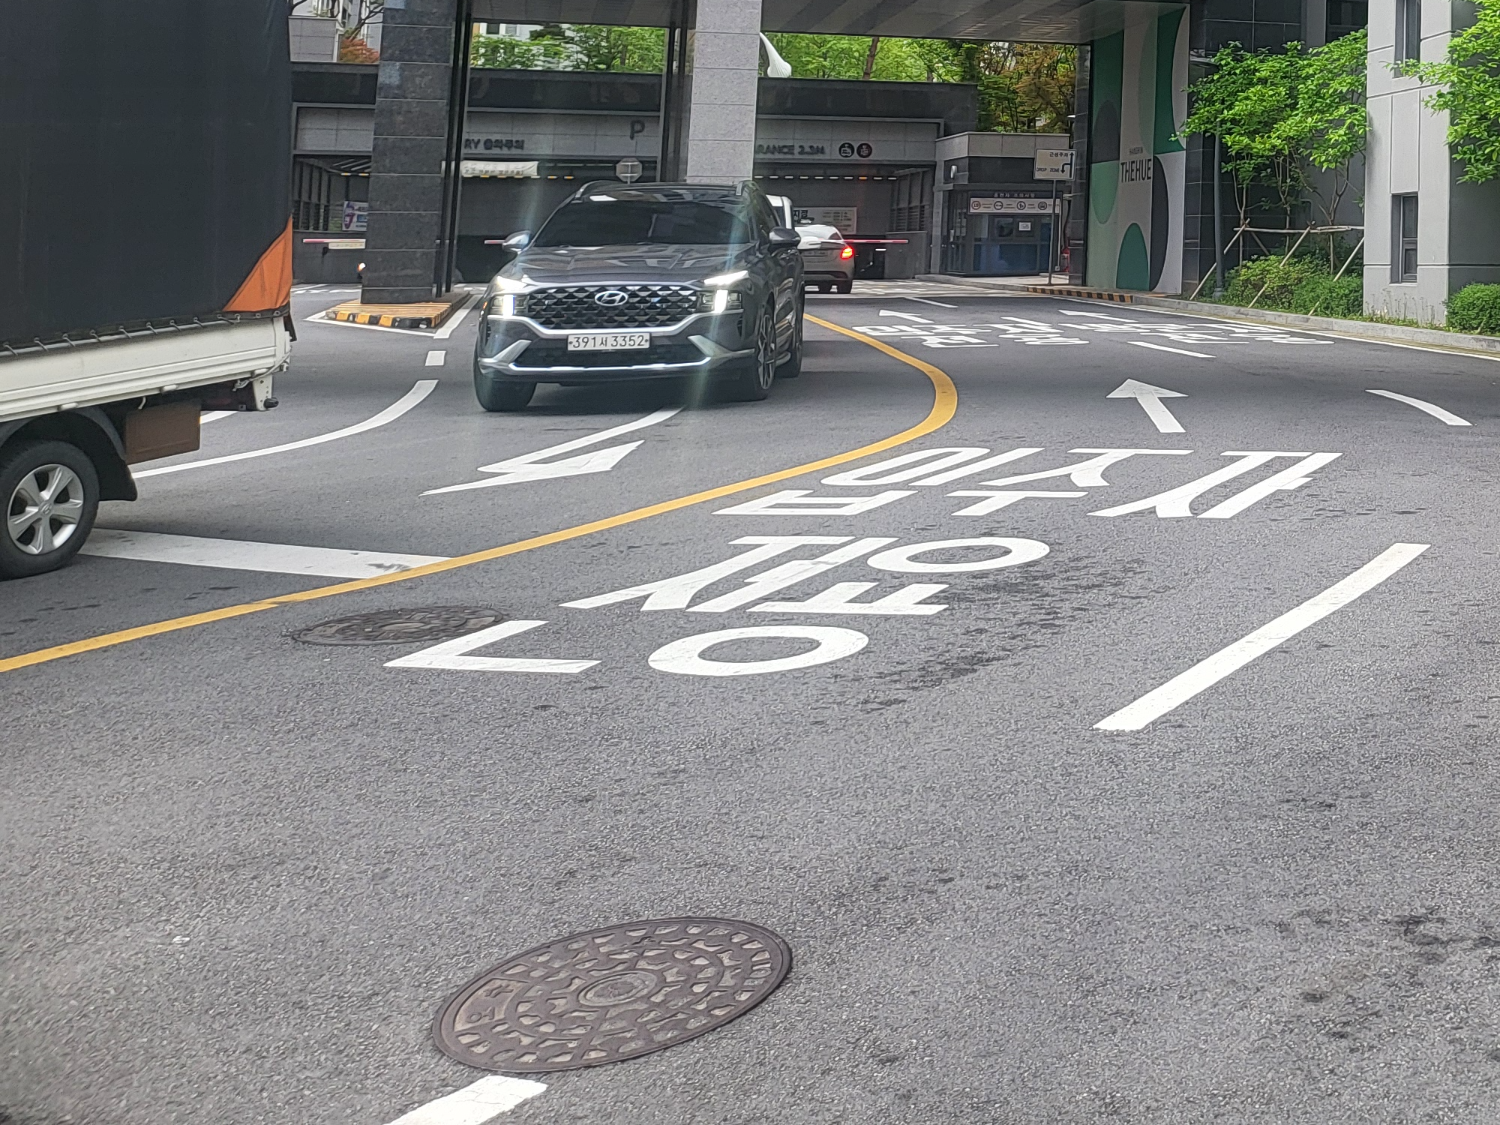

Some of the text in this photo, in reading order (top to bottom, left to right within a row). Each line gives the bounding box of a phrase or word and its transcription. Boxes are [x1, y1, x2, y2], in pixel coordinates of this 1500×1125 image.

[630, 120, 645, 140] P
[1121, 159, 1152, 183] THEHUE
[712, 447, 1342, 519] 입주자
[384, 535, 1051, 677] 전용
